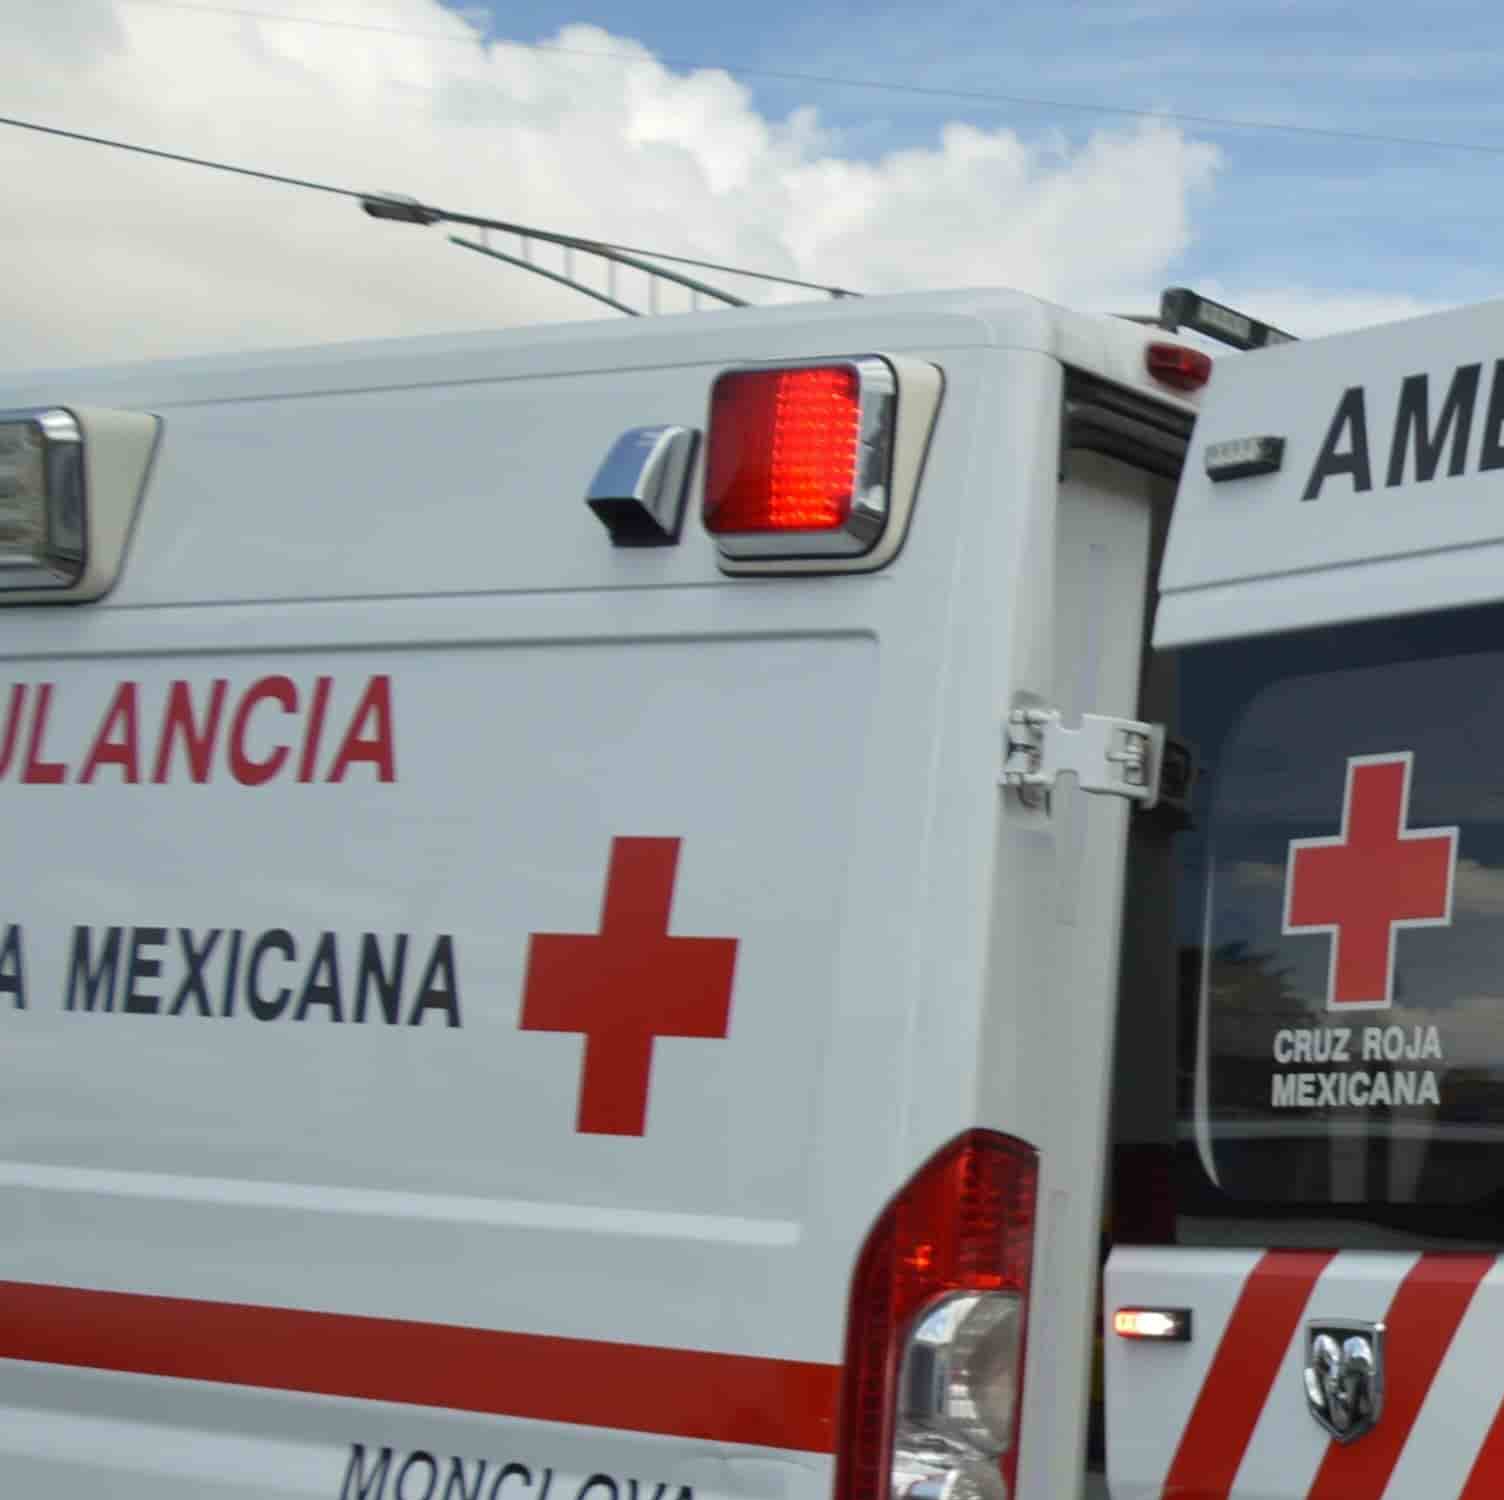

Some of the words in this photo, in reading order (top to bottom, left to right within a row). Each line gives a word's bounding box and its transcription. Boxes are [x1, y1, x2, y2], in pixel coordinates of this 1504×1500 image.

[63, 925, 462, 1029] MEXICANA
[1273, 1027, 1351, 1063] CRUZ
[1361, 1024, 1442, 1061] ROJA
[1271, 1070, 1441, 1107] MEXICANA
